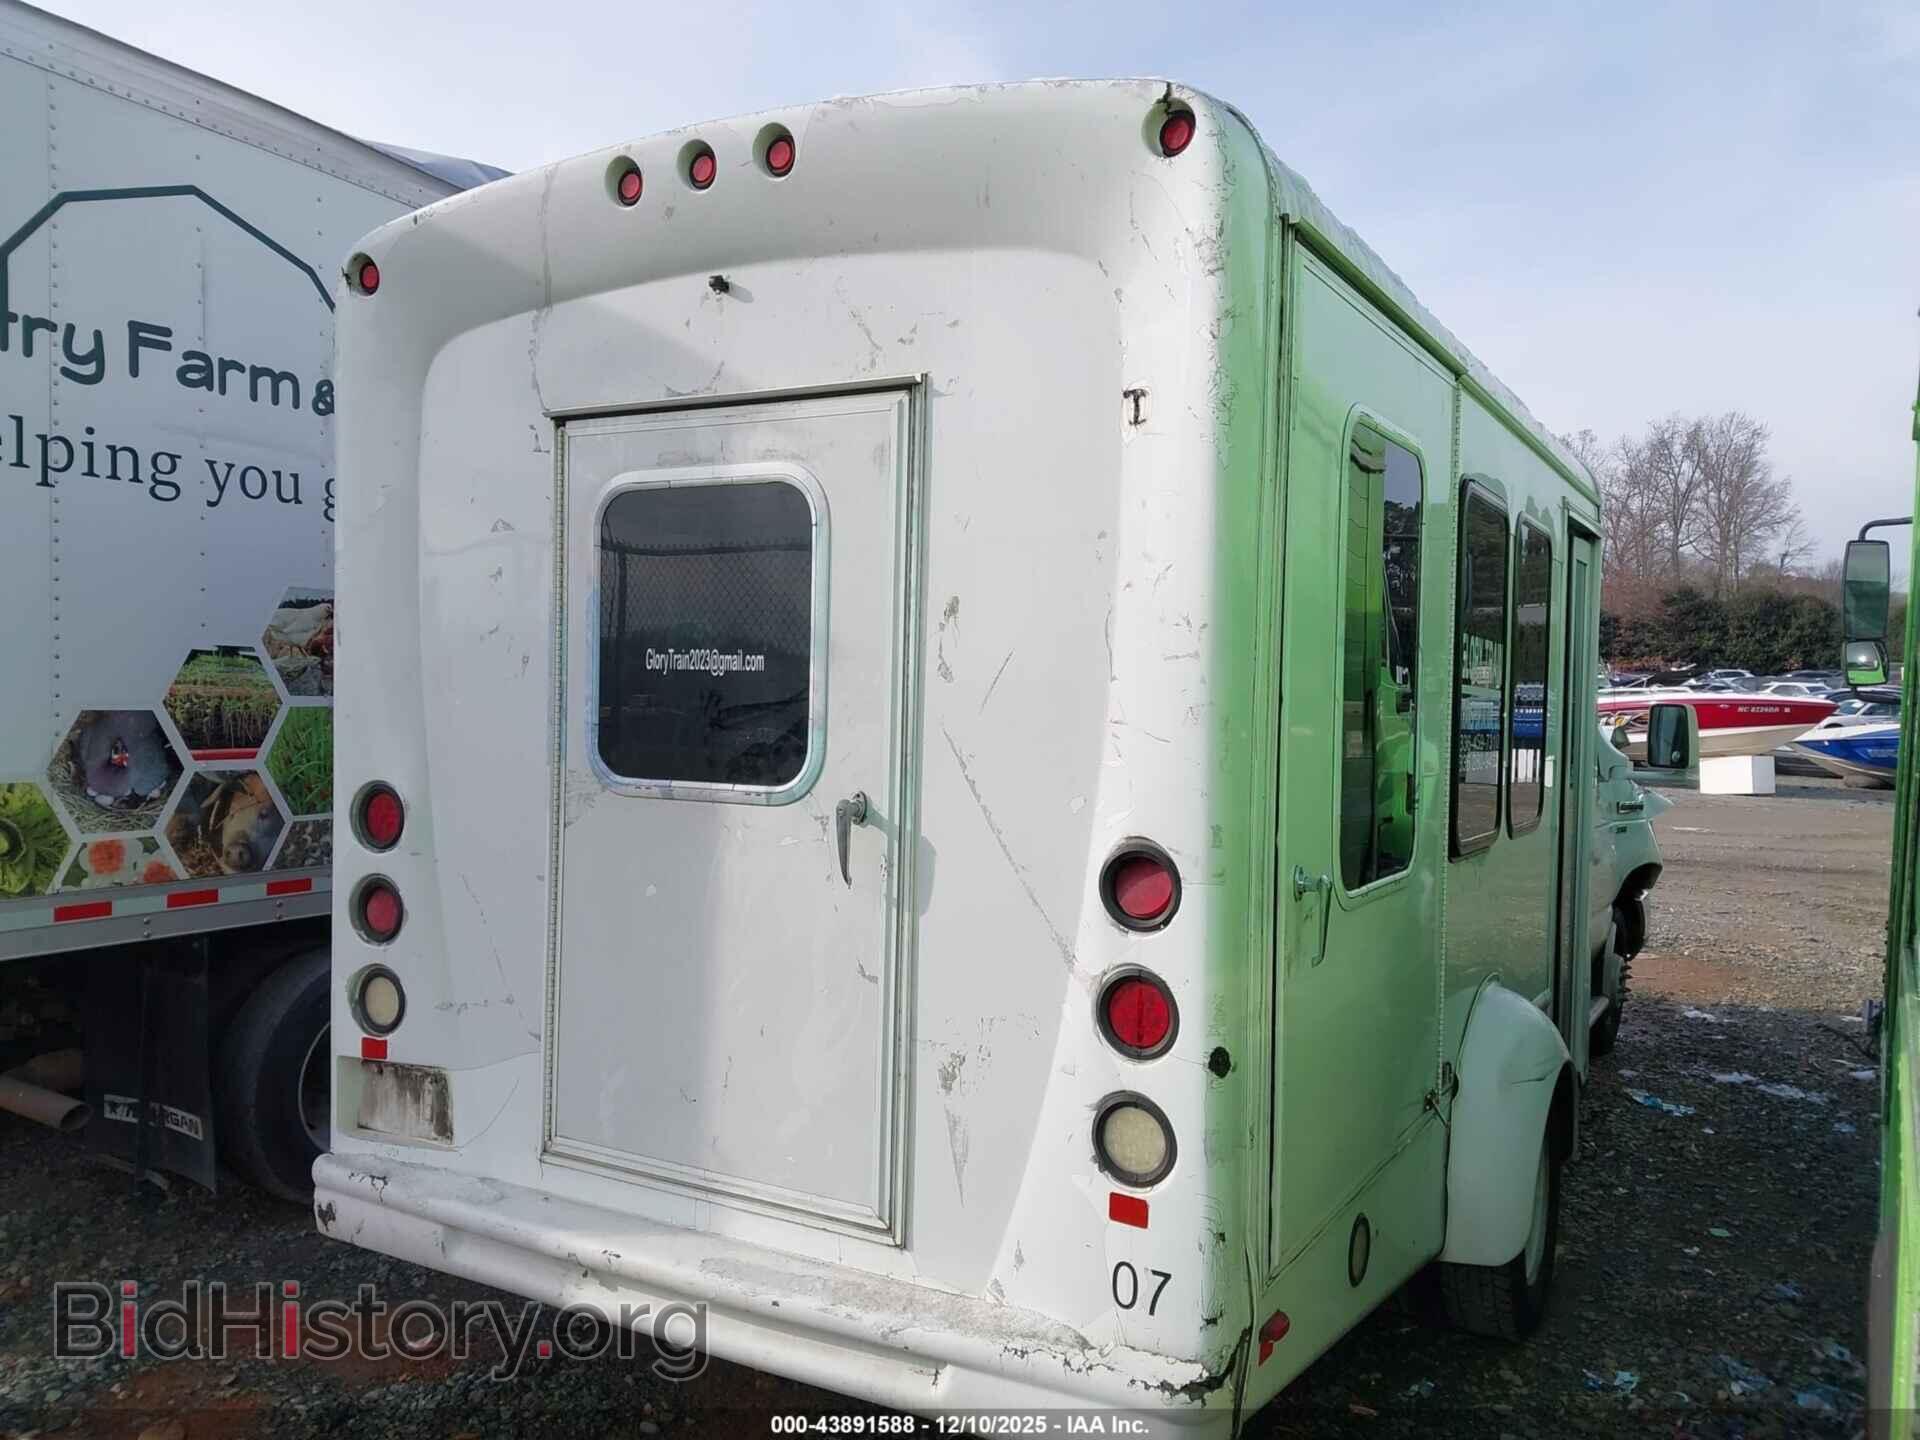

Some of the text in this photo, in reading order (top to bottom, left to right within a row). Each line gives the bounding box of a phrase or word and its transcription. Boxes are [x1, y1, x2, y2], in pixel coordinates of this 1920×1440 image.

[128, 320, 300, 410] Farm
[0, 414, 182, 502] lping
[204, 458, 303, 507] you
[645, 648, 765, 676] GloryTrain2023@gmail.com
[1113, 1261, 1171, 1315] 07
